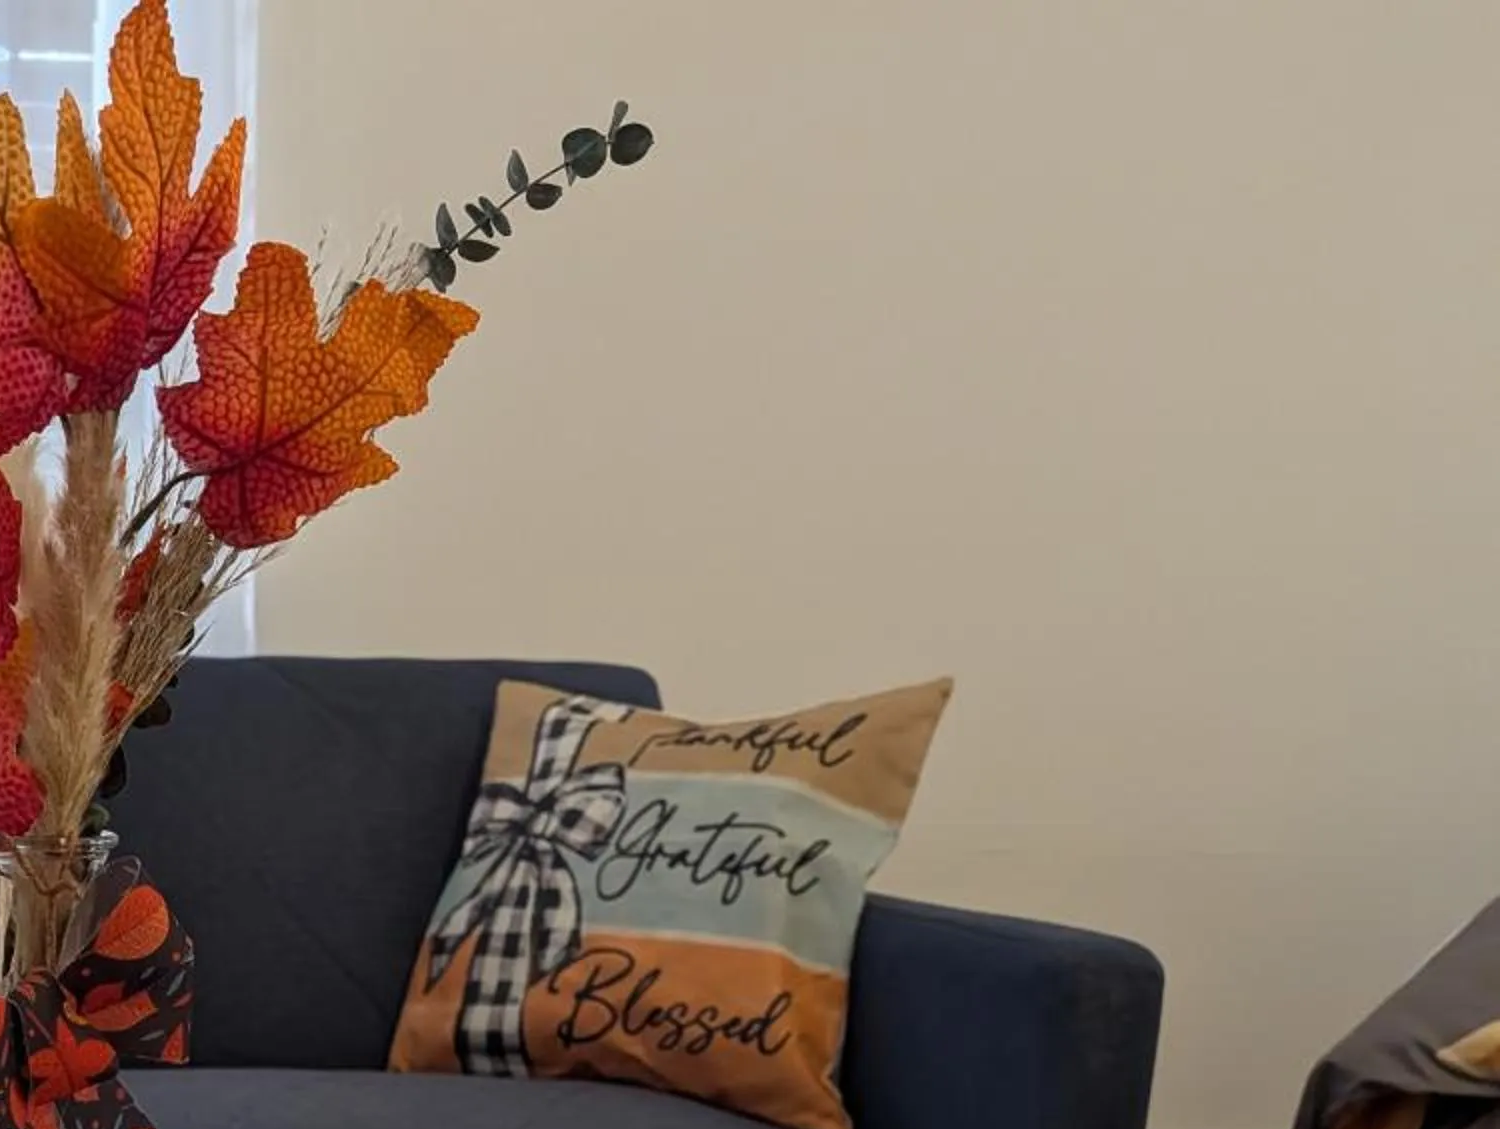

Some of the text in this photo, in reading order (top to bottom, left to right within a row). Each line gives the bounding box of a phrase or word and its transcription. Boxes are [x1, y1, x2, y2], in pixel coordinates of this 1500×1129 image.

[619, 709, 868, 774] ankful
[596, 799, 831, 904] Grateful
[547, 947, 793, 1056] Blessed
